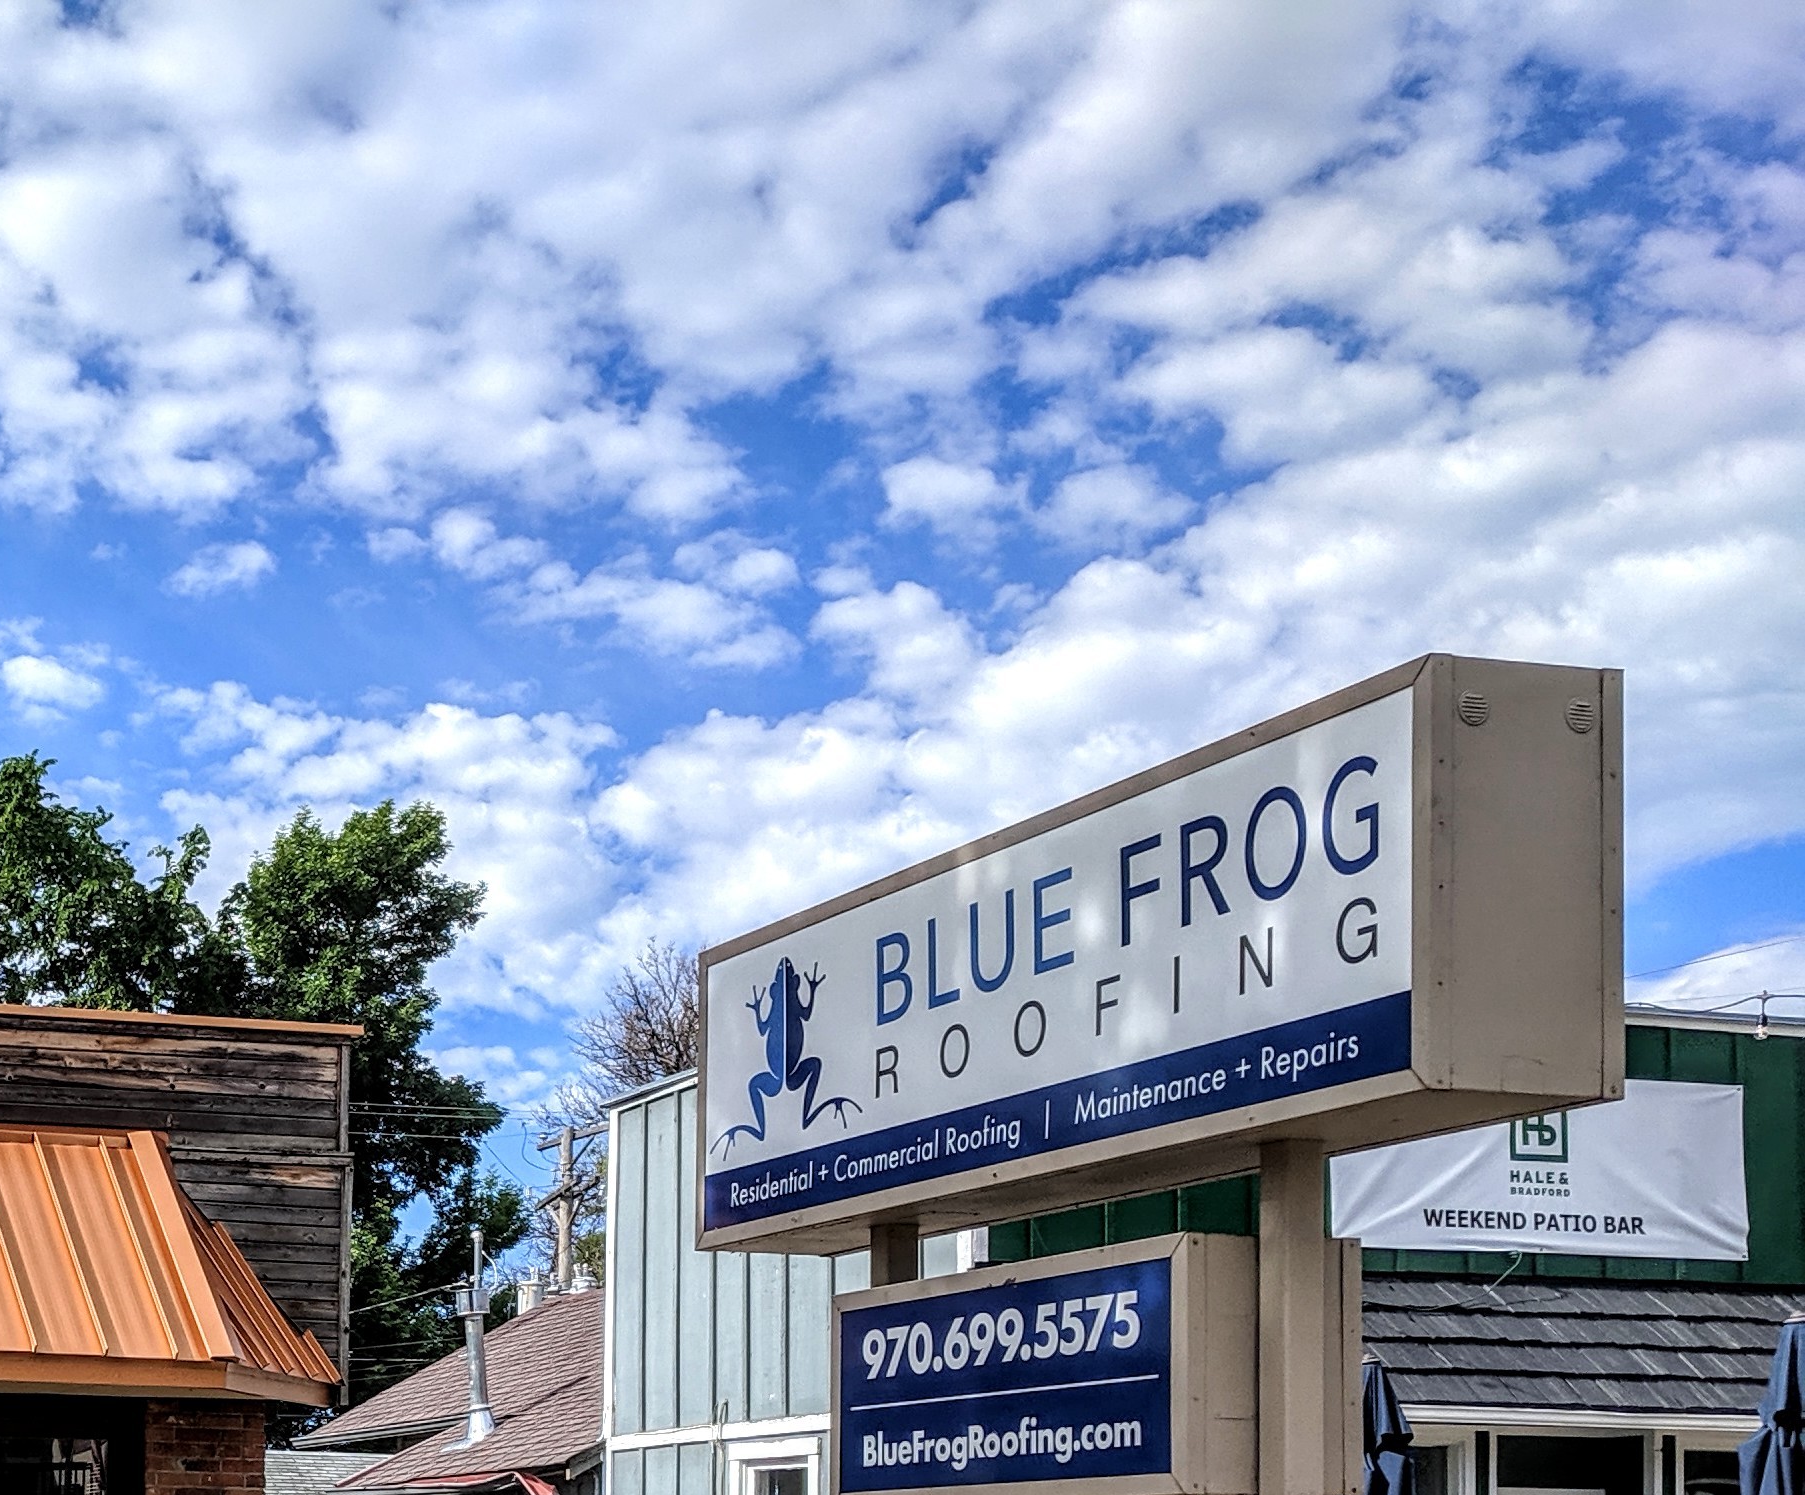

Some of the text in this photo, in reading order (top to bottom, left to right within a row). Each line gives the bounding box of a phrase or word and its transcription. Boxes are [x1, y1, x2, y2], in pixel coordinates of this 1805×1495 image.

[875, 755, 1380, 1026] BLUE FROG
[875, 897, 1379, 1099] ROOFING
[1074, 1067, 1227, 1124] Maintenance
[1261, 1032, 1359, 1082] Repairs
[730, 1161, 813, 1207] Residential
[834, 1129, 939, 1182] Commercial
[946, 1114, 1021, 1156] Roofing
[1509, 1170, 1555, 1184] HALE
[1509, 1187, 1571, 1198] BRADFORD
[1423, 1207, 1646, 1235] WEEKEND PATIO BAR
[862, 1290, 1141, 1380] 970.699.5575
[862, 1416, 1142, 1472] BlueFrogRoofing.com
